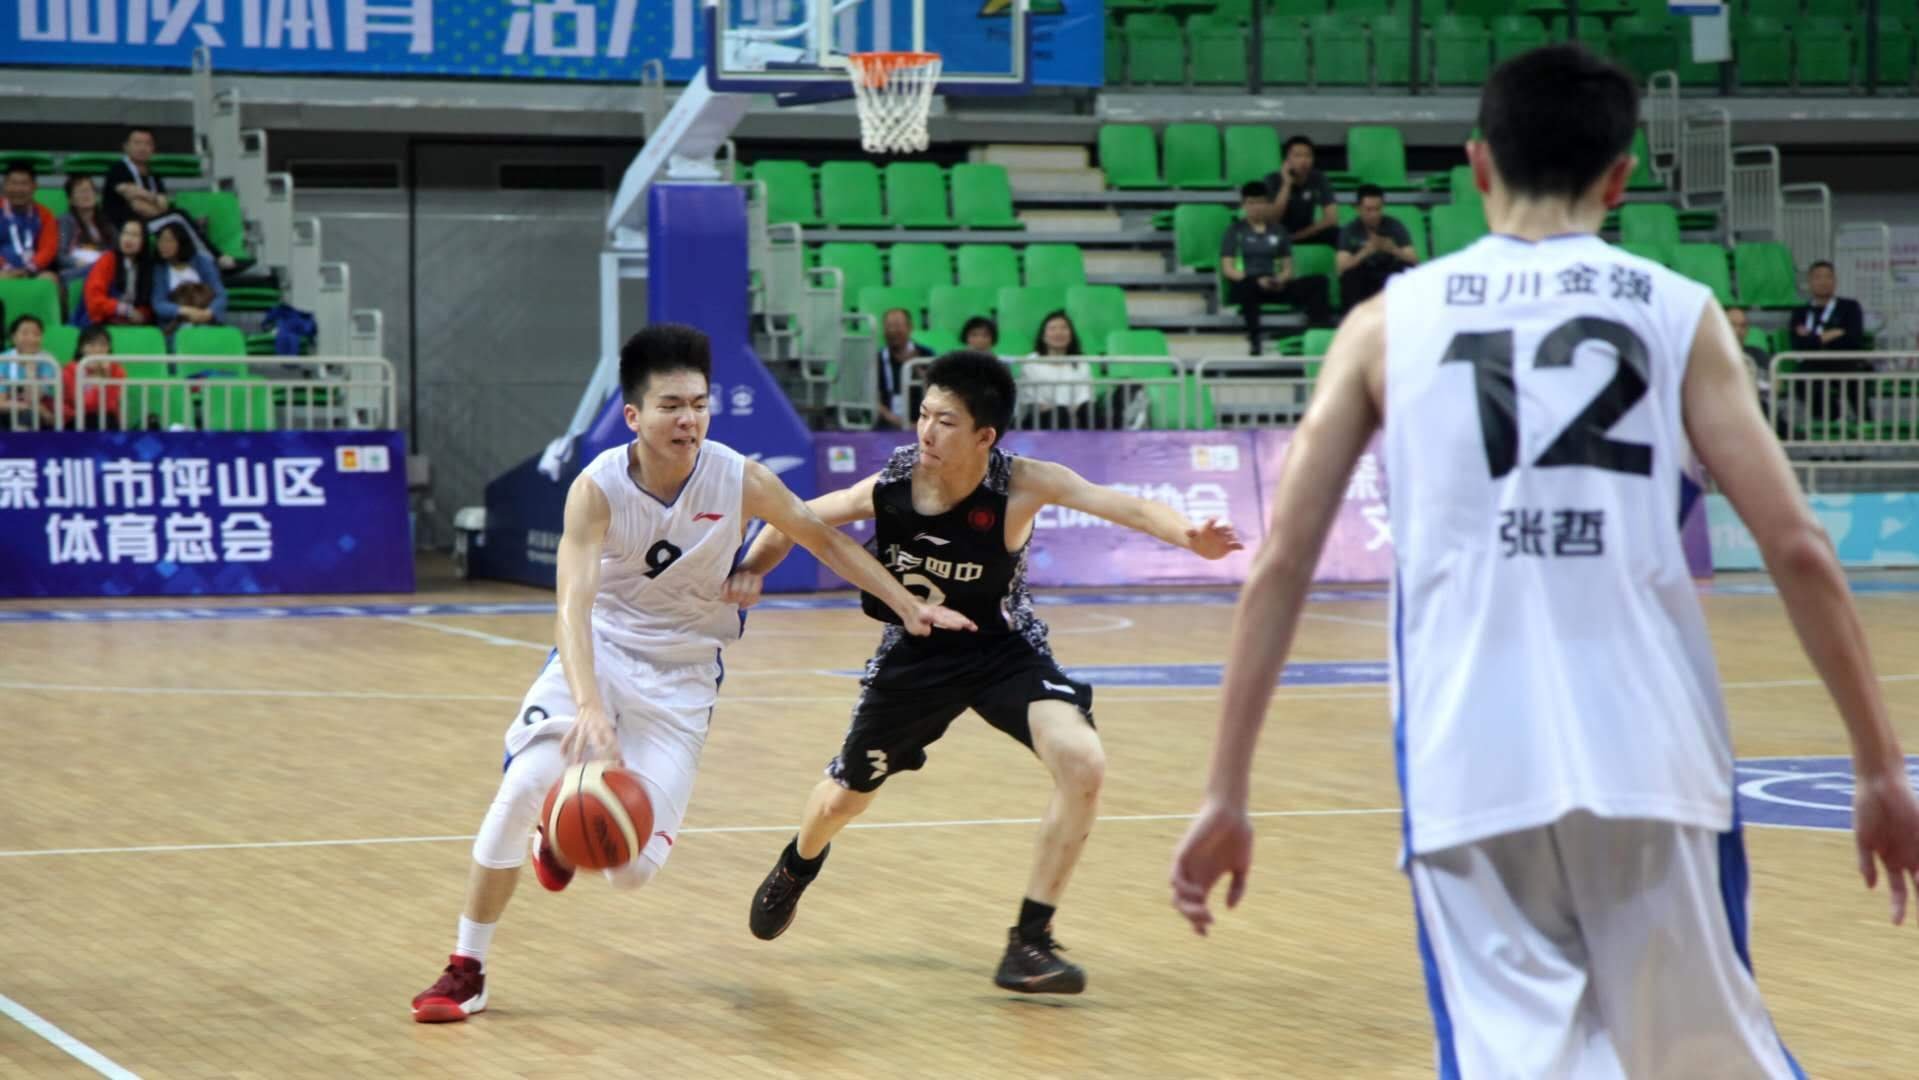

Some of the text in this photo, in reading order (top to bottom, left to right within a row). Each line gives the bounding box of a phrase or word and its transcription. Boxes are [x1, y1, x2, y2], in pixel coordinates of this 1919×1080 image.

[1446, 263, 1652, 305] 四川金强
[1439, 315, 1654, 479] 12
[0, 458, 326, 508] 深圳市坪山区
[46, 513, 273, 563] 体育总会
[1500, 508, 1604, 558] 张哲
[643, 539, 682, 579] 9
